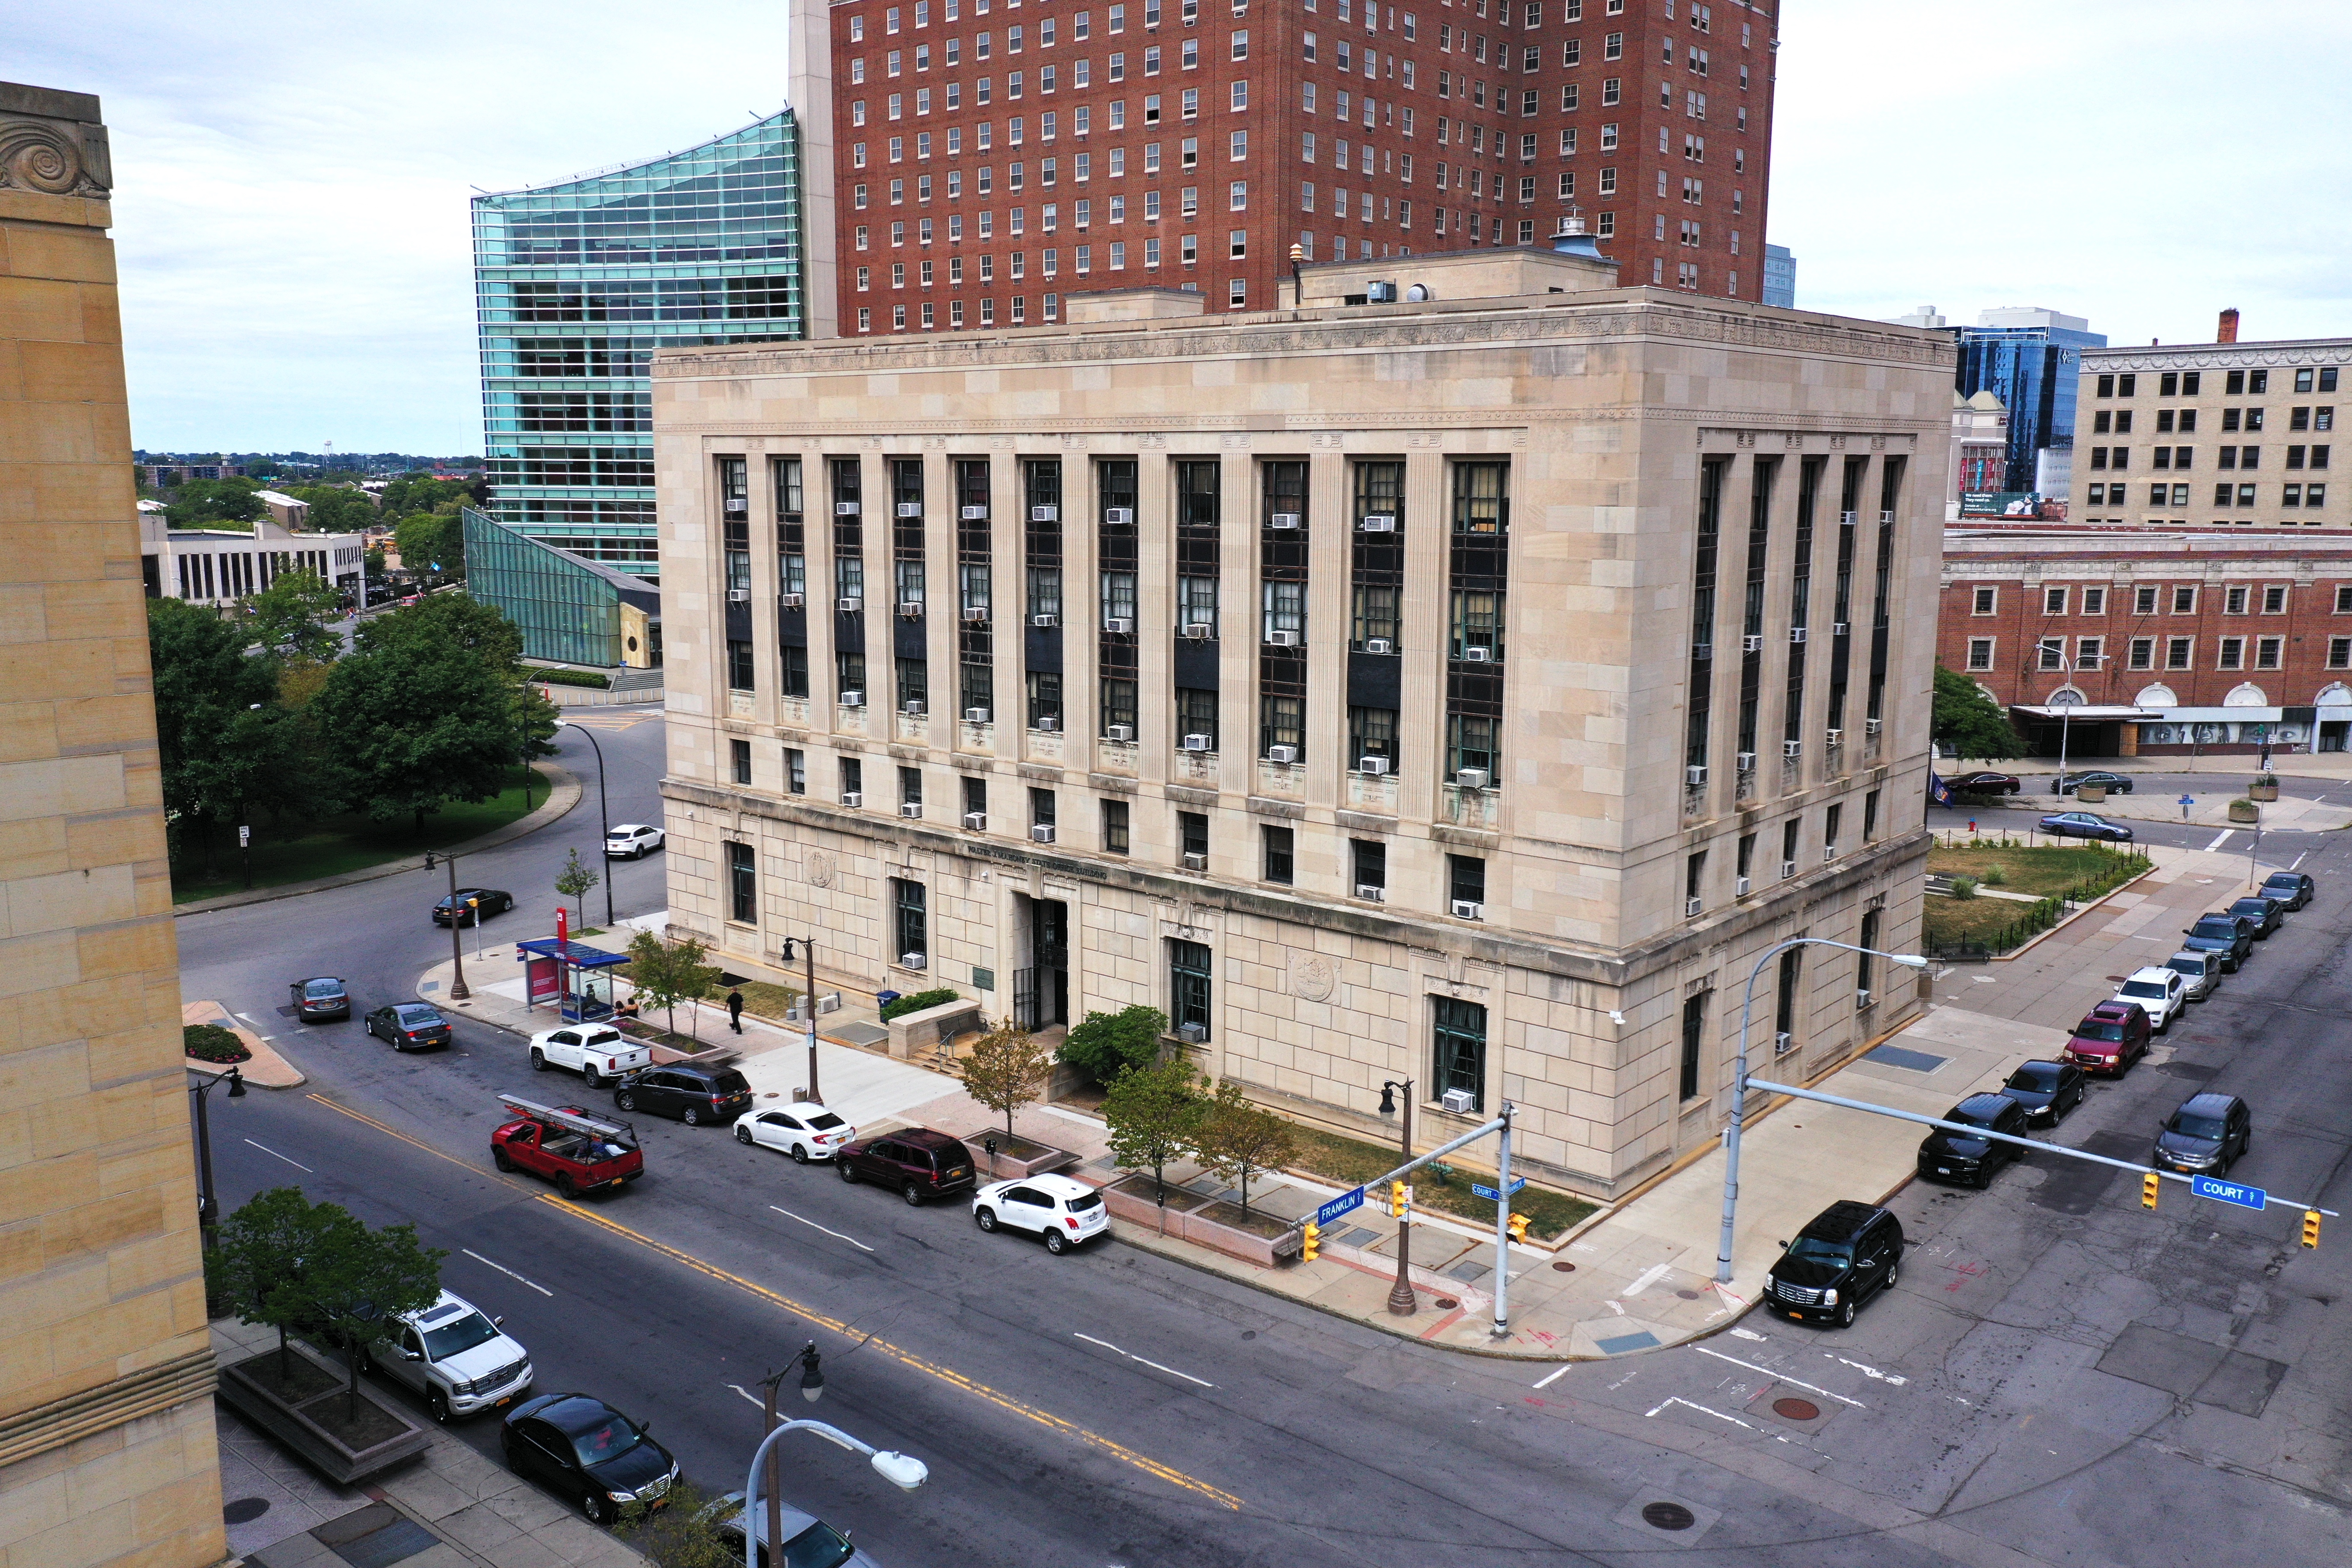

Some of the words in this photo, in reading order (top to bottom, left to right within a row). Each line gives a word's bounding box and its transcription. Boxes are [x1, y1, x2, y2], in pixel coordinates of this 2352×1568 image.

[968, 845, 991, 857] WALTER
[998, 851, 1030, 863] MAHONEY
[1032, 858, 1050, 868] STATE
[1054, 862, 1074, 873] OFFICE
[1076, 867, 1107, 880] BUILDING
[1473, 1186, 1492, 1197] COURT
[2203, 1182, 2244, 1200] COURT
[2249, 1192, 2254, 1202] ST
[1322, 1194, 1355, 1220] FRANKLIN
[1357, 1192, 1360, 1203] ST
